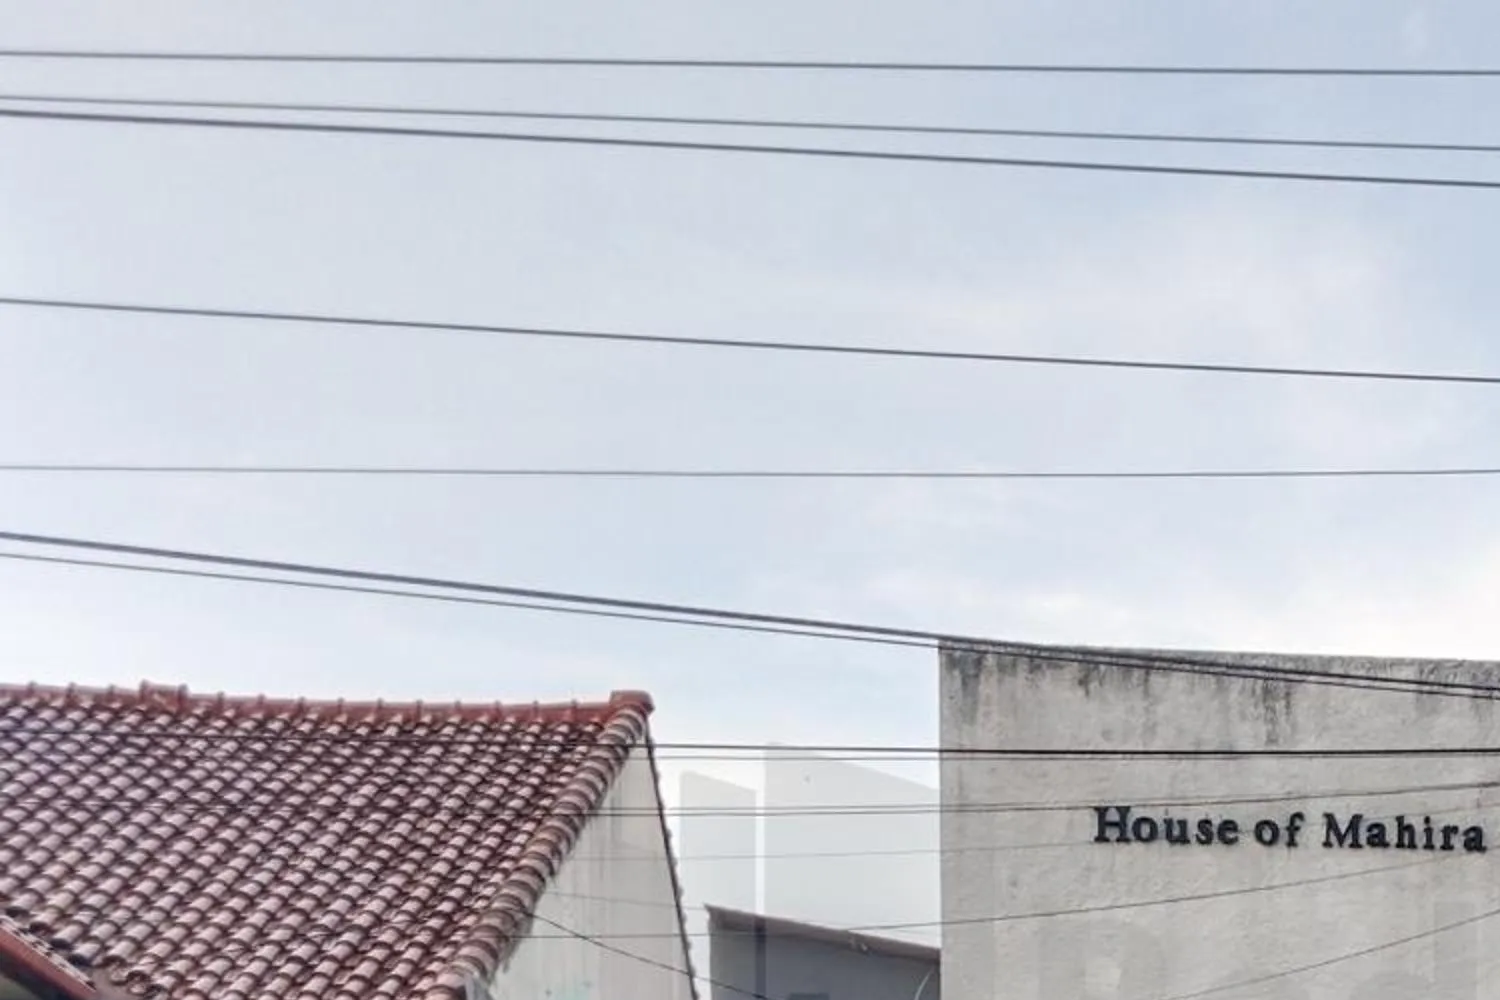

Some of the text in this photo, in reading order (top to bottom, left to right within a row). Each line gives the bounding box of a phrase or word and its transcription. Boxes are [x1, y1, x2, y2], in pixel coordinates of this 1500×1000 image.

[1094, 806, 1488, 853] House of Mahira
